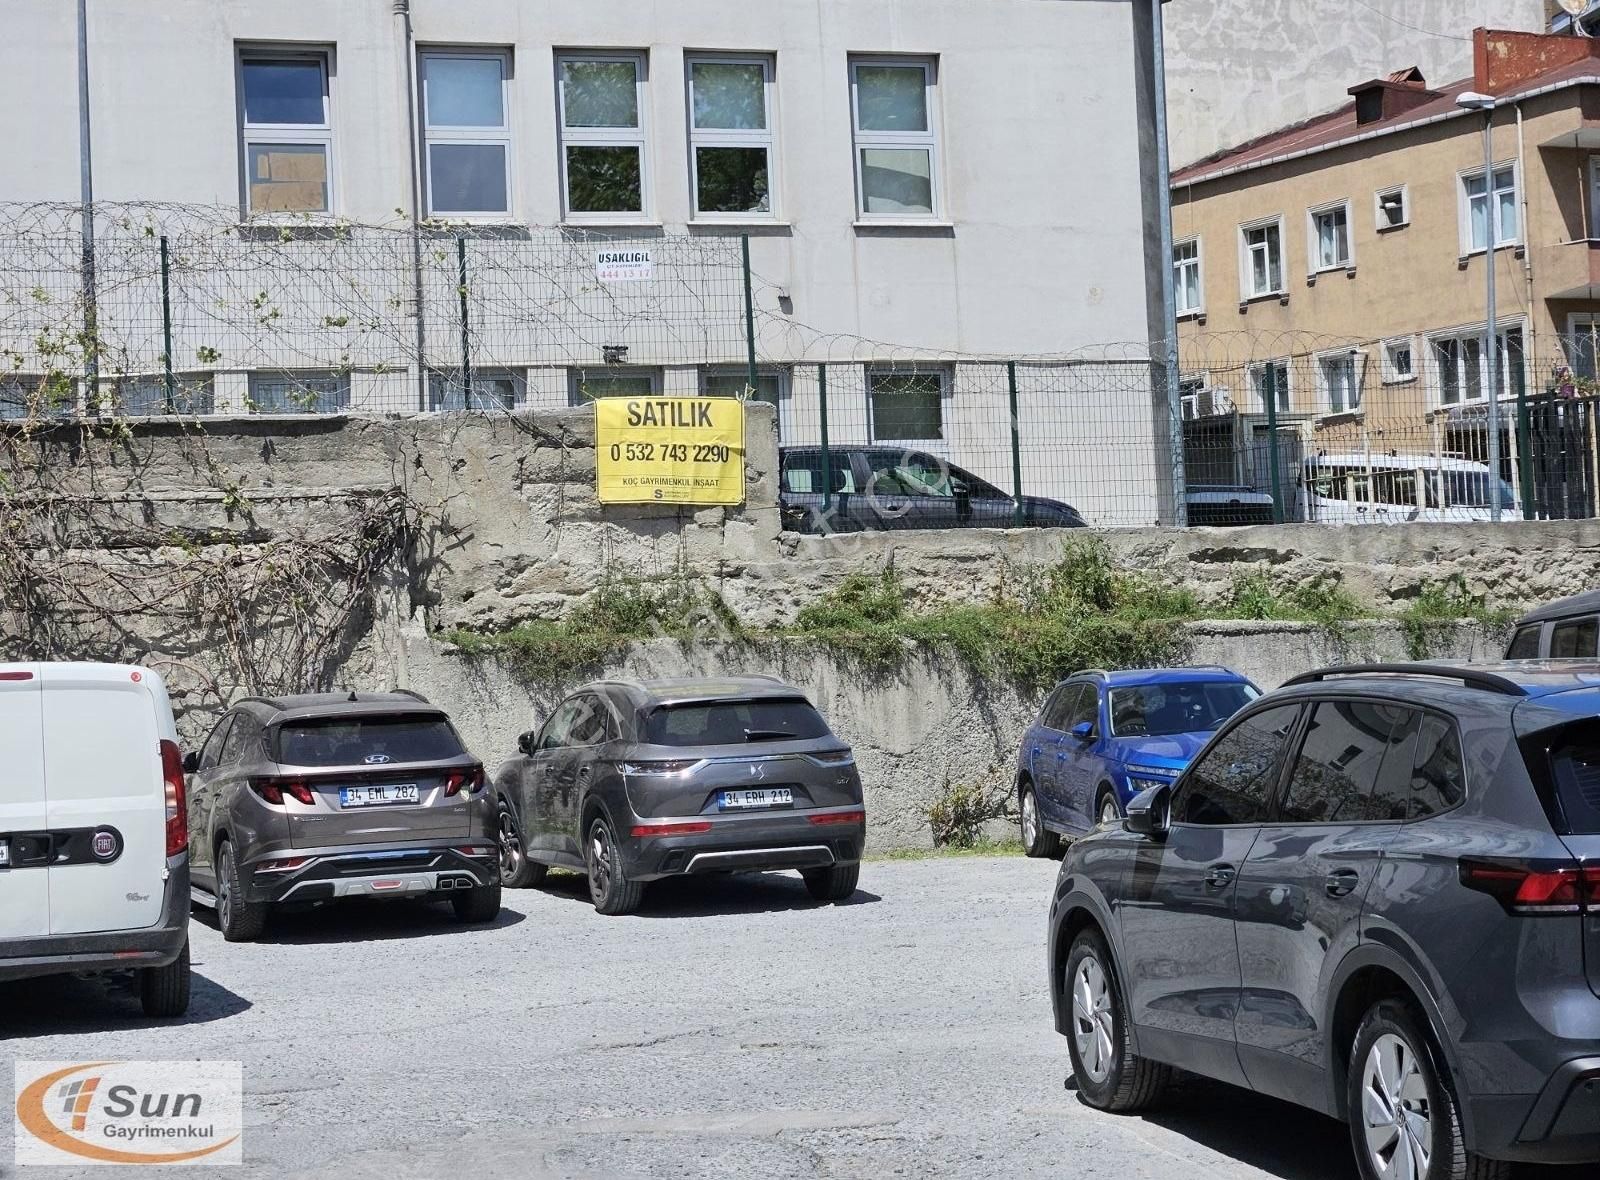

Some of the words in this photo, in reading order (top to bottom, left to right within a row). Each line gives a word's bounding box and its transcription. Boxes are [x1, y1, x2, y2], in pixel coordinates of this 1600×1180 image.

[627, 401, 713, 427] SATILIK
[610, 443, 621, 461] 0
[626, 443, 655, 461] 532
[660, 444, 688, 462] 743
[692, 444, 730, 463] 2290
[347, 788, 362, 802] 34
[367, 786, 389, 800] EML
[394, 785, 416, 799] 282
[725, 792, 739, 805] 34
[745, 791, 766, 804] ERH
[770, 789, 791, 803] 212
[97, 838, 112, 850] FIAT
